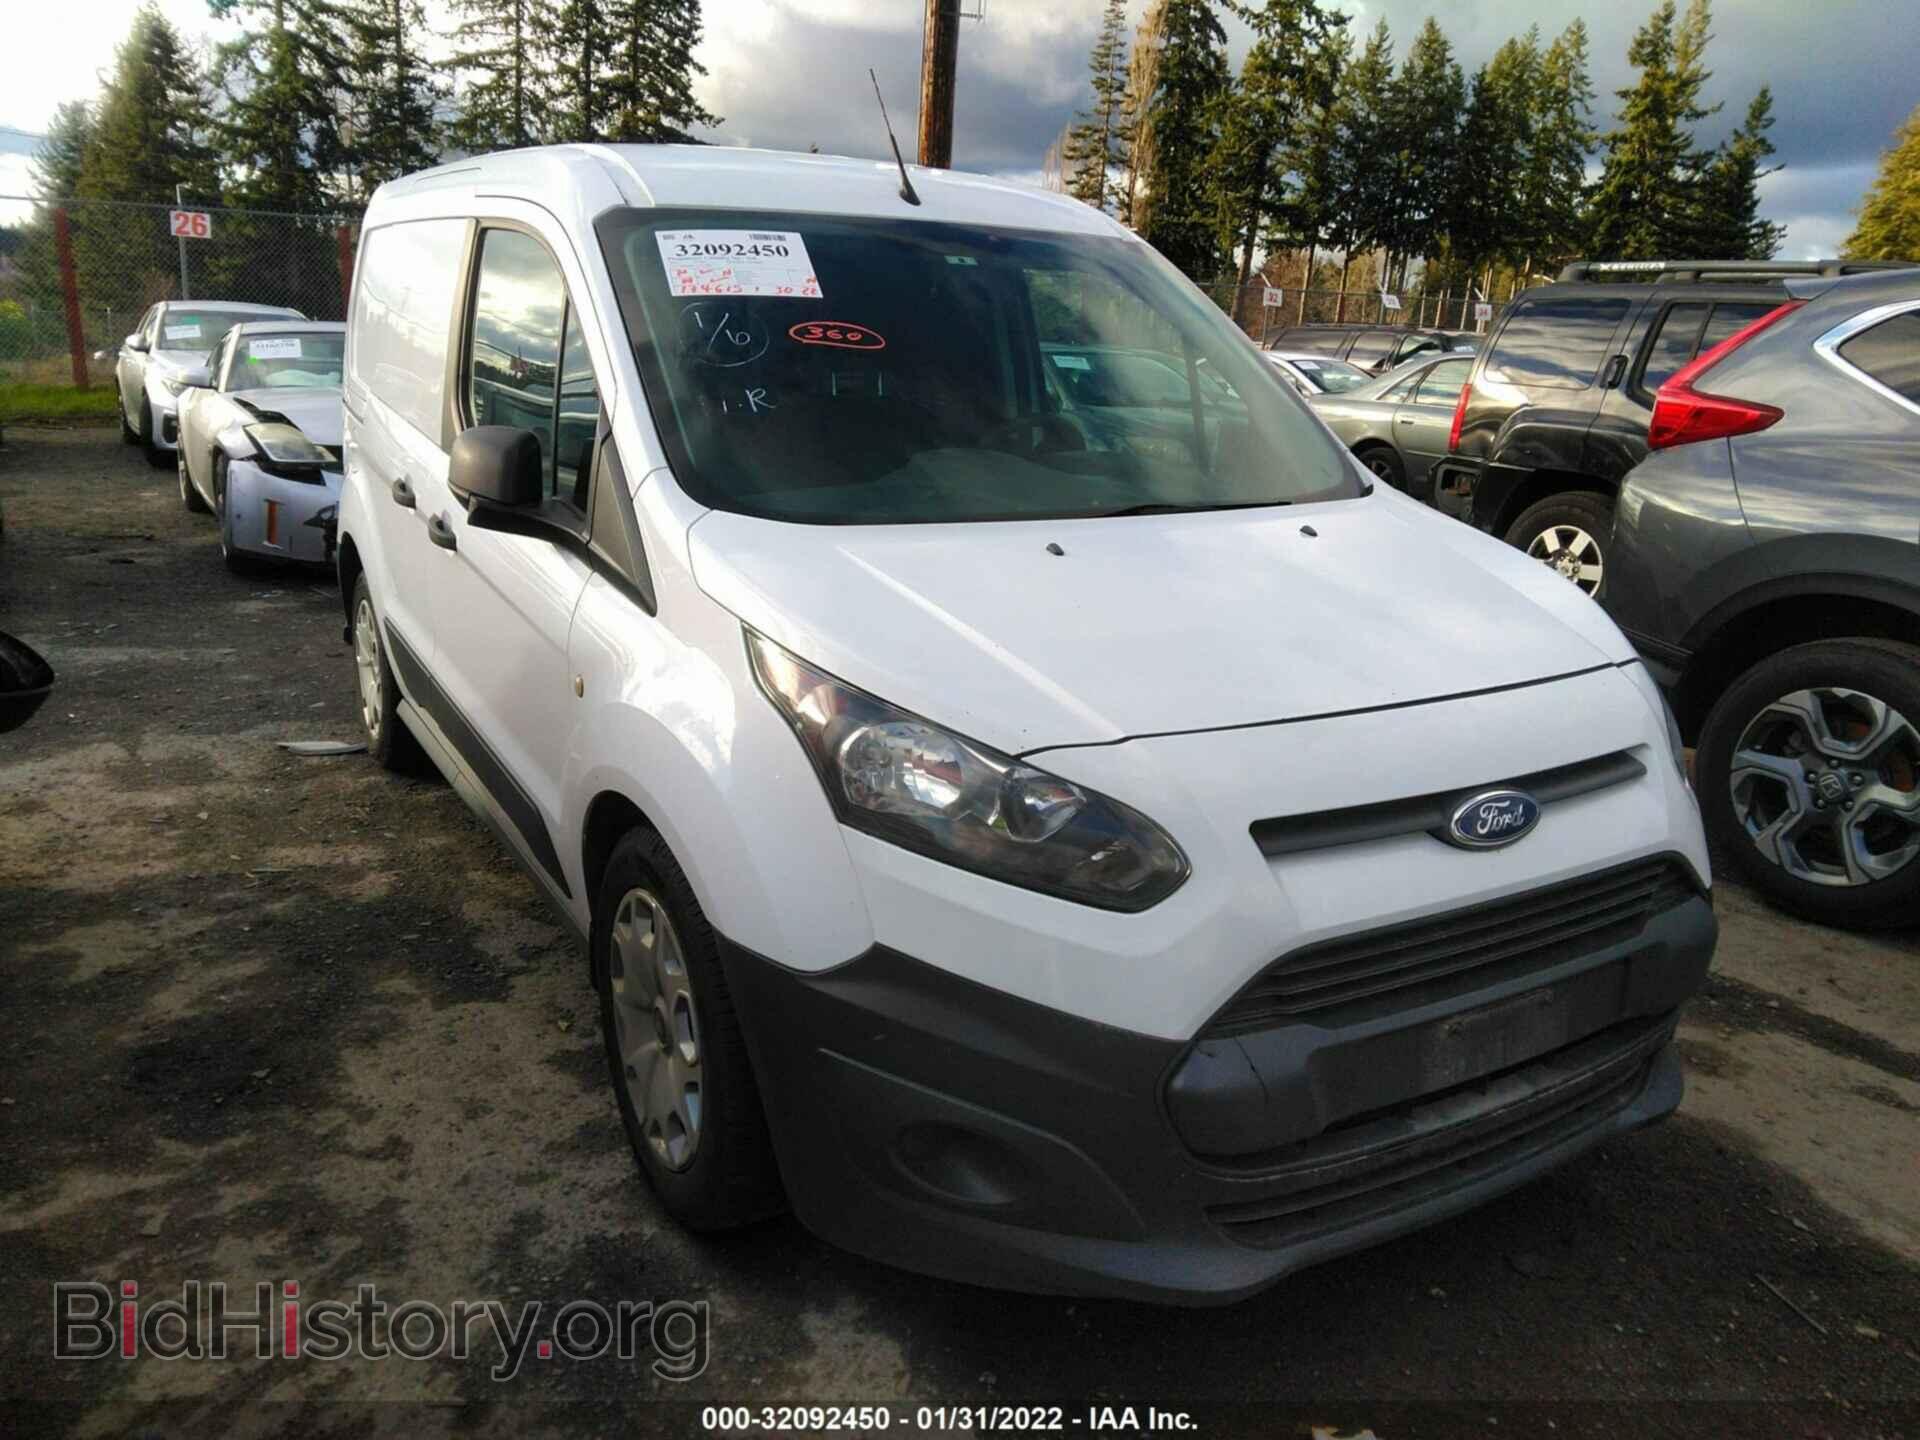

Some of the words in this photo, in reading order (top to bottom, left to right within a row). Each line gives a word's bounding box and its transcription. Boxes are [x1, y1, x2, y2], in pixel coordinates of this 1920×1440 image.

[175, 211, 209, 237] 26
[674, 243, 790, 258] 32092450
[803, 324, 864, 342] 360
[1477, 800, 1524, 834] Ford
